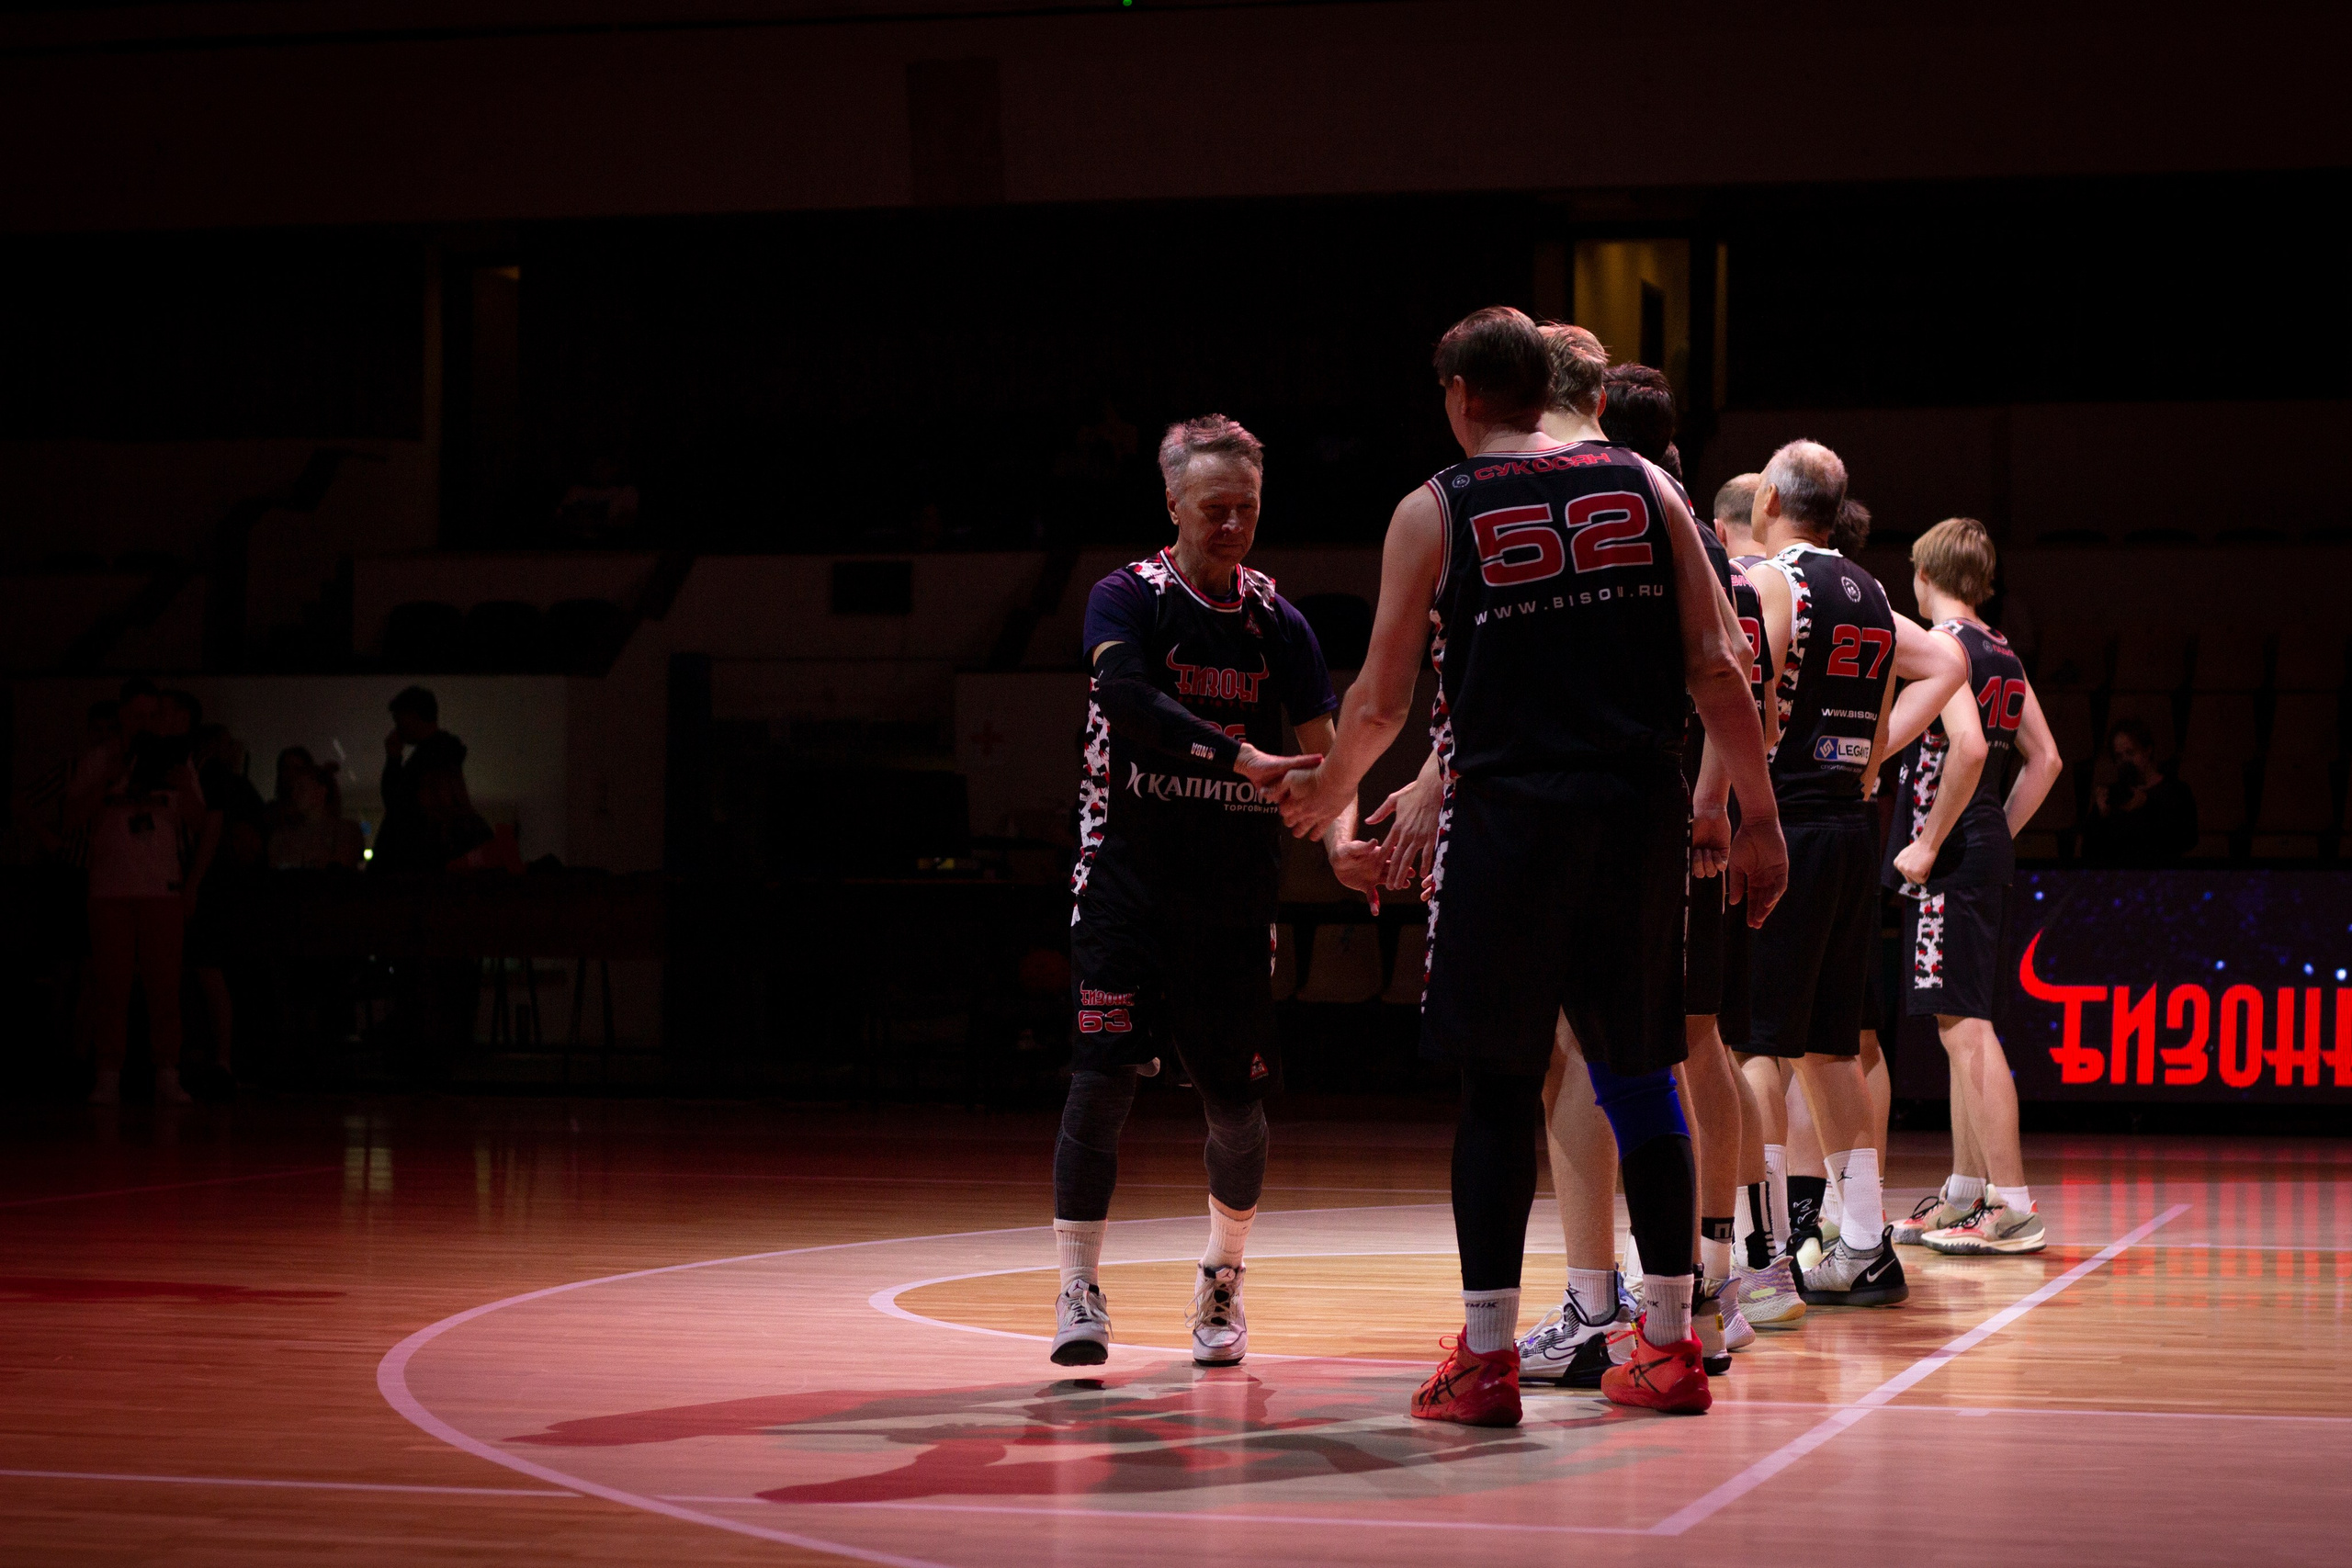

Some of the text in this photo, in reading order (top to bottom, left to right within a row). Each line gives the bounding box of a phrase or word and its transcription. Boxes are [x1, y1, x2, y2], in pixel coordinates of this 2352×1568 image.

[1469, 490, 1654, 588] 52
[1826, 624, 1893, 680] 27
[1976, 675, 2026, 731] 10
[1078, 1009, 1133, 1033] 63
